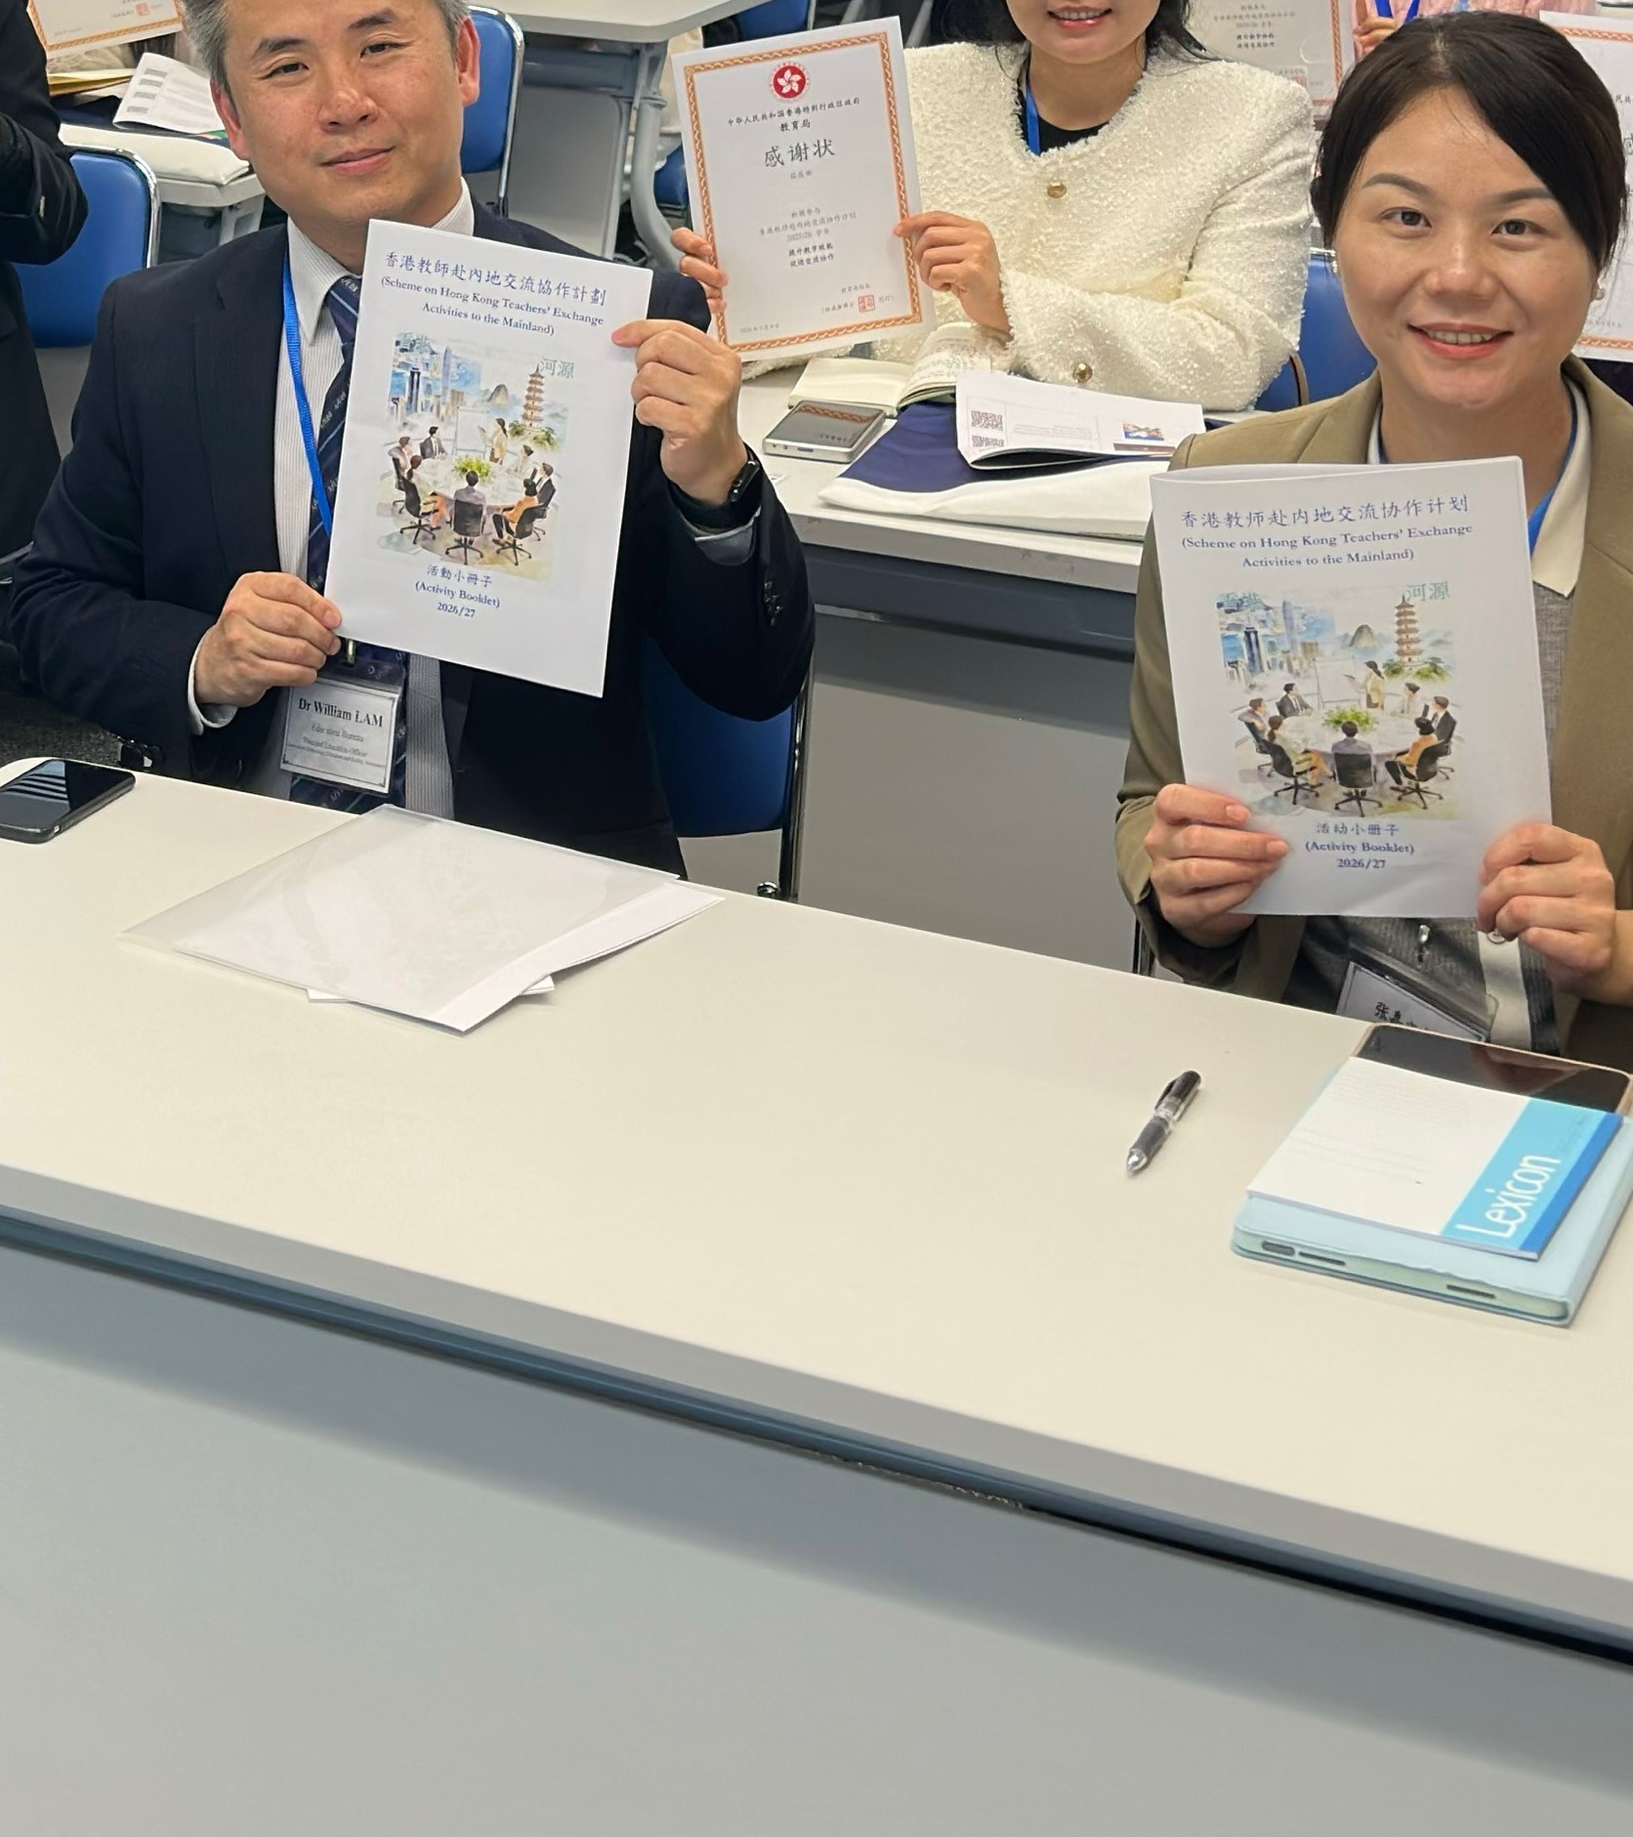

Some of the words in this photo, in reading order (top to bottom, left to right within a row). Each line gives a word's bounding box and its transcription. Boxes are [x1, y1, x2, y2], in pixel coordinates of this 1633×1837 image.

[780, 119, 811, 132] 教育局
[764, 138, 836, 168] 感谢状
[381, 276, 423, 294] (Scheme
[424, 286, 438, 296] on
[440, 286, 469, 304] Hong
[472, 293, 500, 310] Kong
[553, 307, 605, 326] Exchange
[422, 302, 469, 320] Activities
[471, 311, 482, 321] to
[483, 311, 500, 324] the
[502, 314, 555, 337] Mainland)
[540, 357, 575, 380] 河源
[1181, 493, 1470, 530] 香港教师赴内地交流协作计划
[1181, 534, 1237, 552] (Scheme
[1239, 537, 1257, 549] on
[1259, 533, 1298, 550] Hong
[1301, 531, 1337, 548] Kong
[1407, 523, 1473, 541] Exchange
[1241, 555, 1303, 568] Activities
[1305, 555, 1318, 566] to
[1322, 552, 1343, 566] the
[1346, 547, 1415, 565] Mainland)
[415, 581, 457, 599] (Activity
[459, 589, 501, 609] Booklet)
[1405, 580, 1450, 603] 河源
[437, 602, 476, 619] 2026/27
[298, 698, 312, 712] Dr
[314, 701, 352, 721] William
[355, 710, 383, 728] LAM
[1305, 839, 1358, 855] (Activity
[1362, 839, 1415, 855] Booklet)
[1336, 858, 1387, 870] 2026/27
[1456, 1154, 1561, 1239] Lexicon
